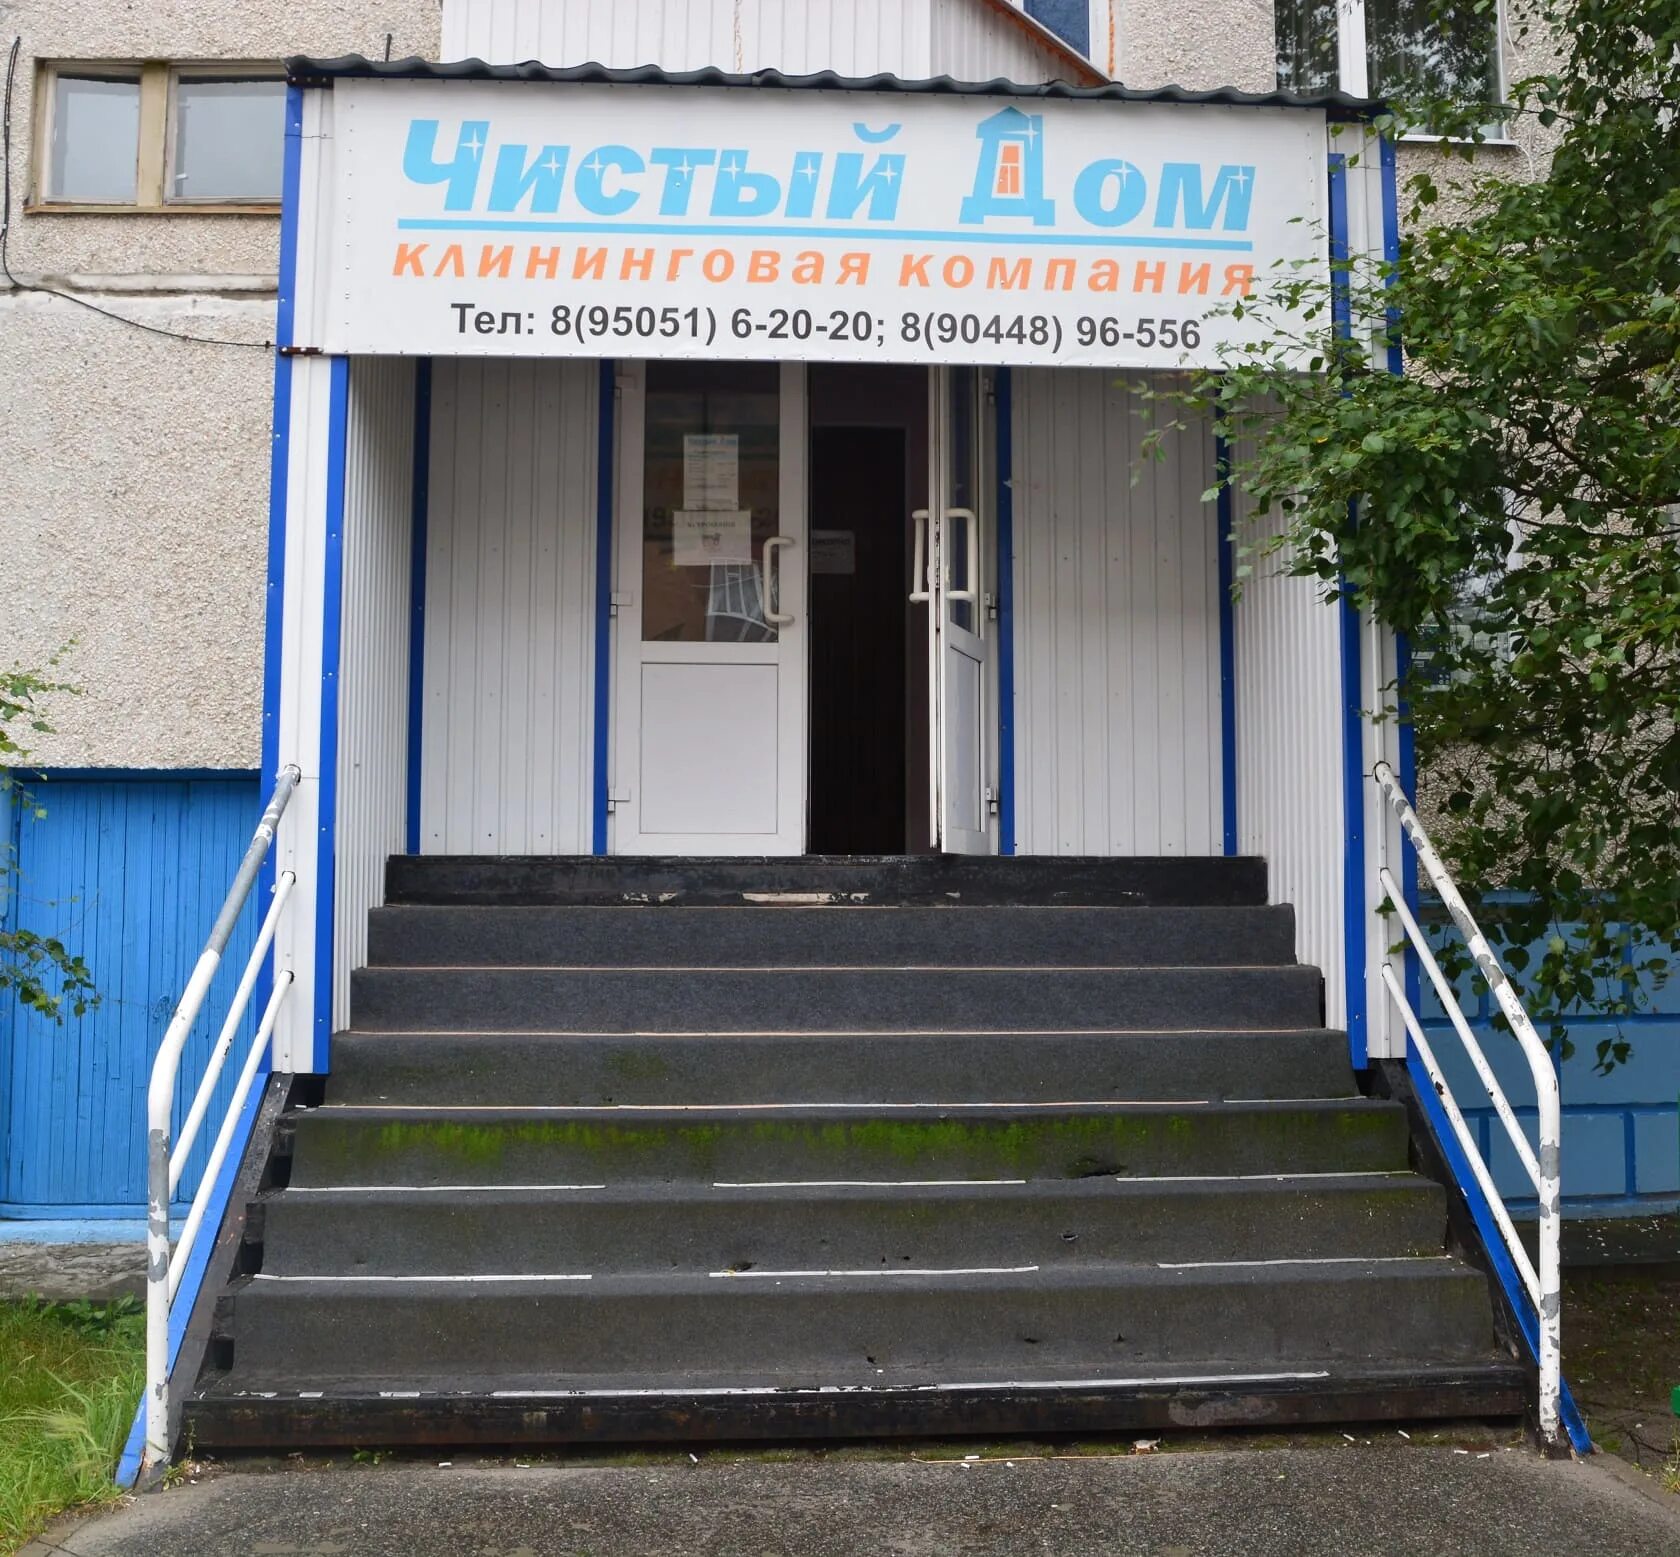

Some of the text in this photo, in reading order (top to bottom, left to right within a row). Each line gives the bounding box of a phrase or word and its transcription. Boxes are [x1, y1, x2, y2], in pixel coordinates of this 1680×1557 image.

[402, 106, 1256, 231] Чистый Дом
[392, 243, 1255, 296] клининговая компания
[451, 303, 1201, 353] Тел: 8(95051) 6-20-20; 8(90448) 96-556
